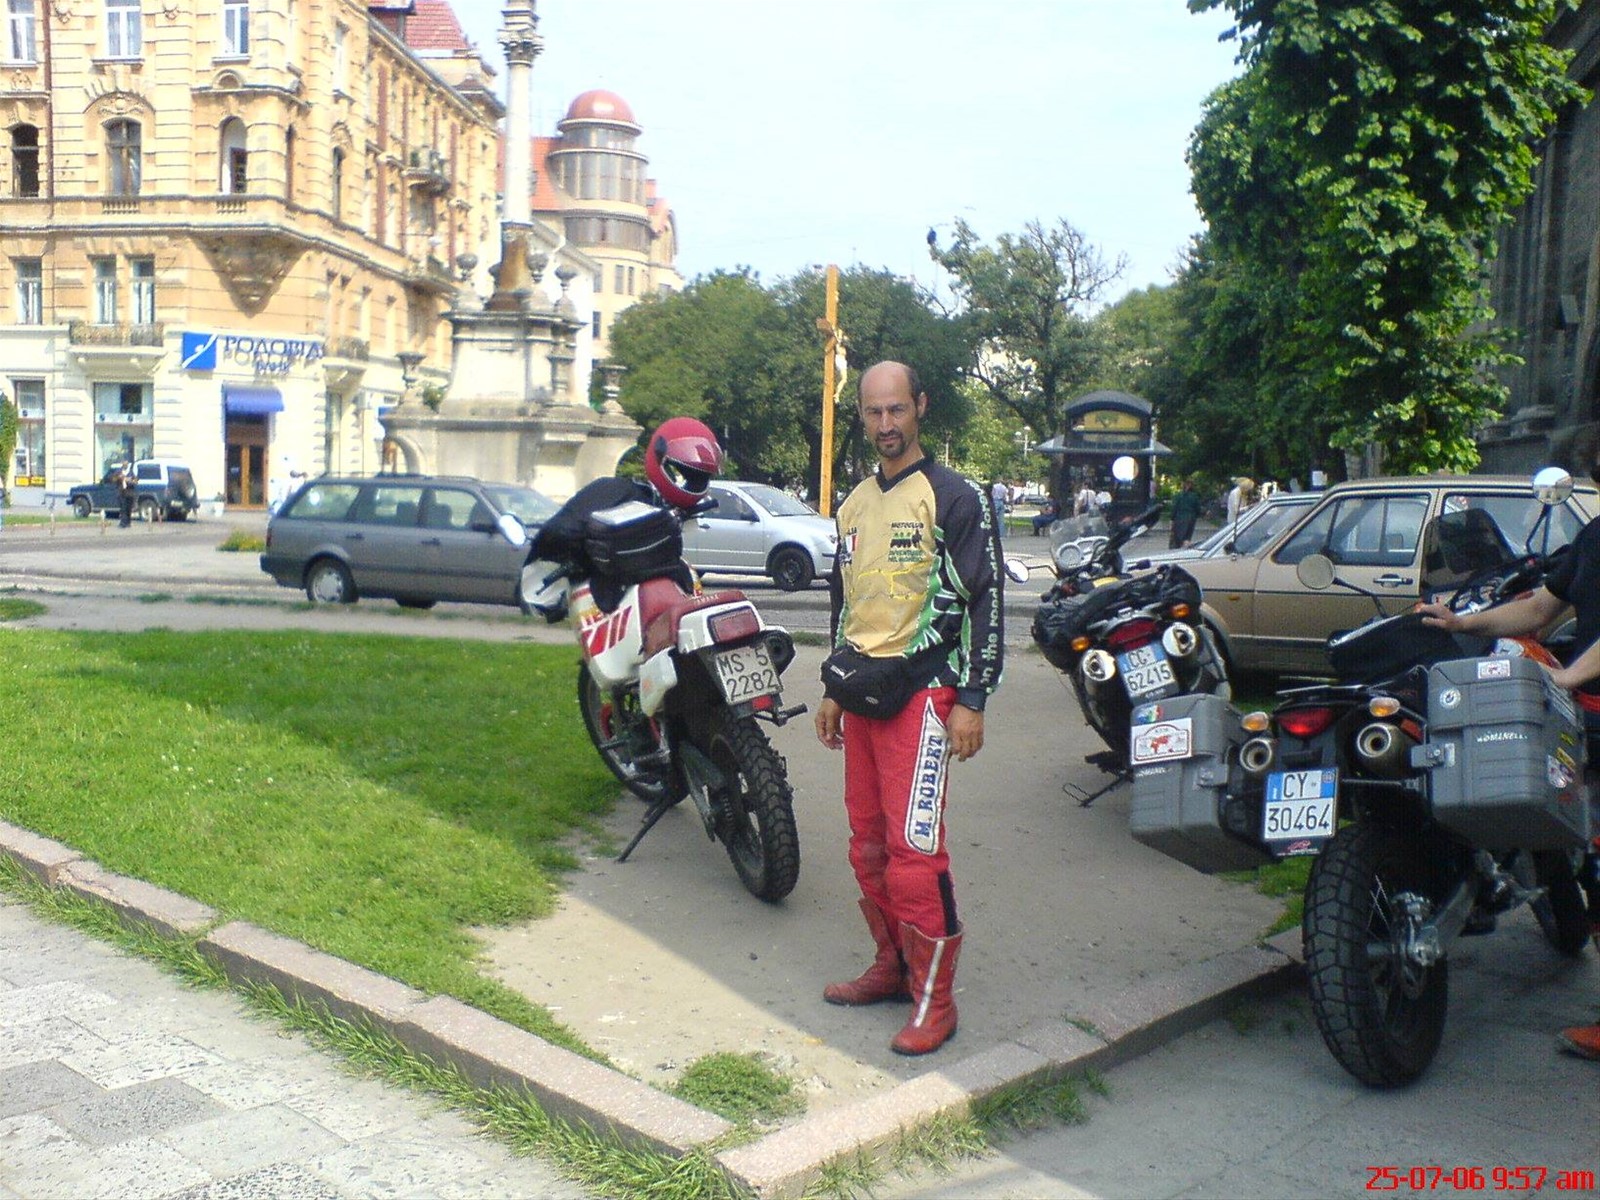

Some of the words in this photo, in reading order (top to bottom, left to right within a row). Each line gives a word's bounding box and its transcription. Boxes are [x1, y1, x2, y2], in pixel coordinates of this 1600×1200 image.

[717, 653, 744, 676] MS
[754, 644, 769, 666] 5
[981, 633, 998, 661] the
[726, 669, 778, 701] 2282
[1127, 663, 1171, 691] 62415
[918, 735, 943, 811] ROBERT
[1283, 772, 1308, 798] CY
[1267, 803, 1330, 833] 30464
